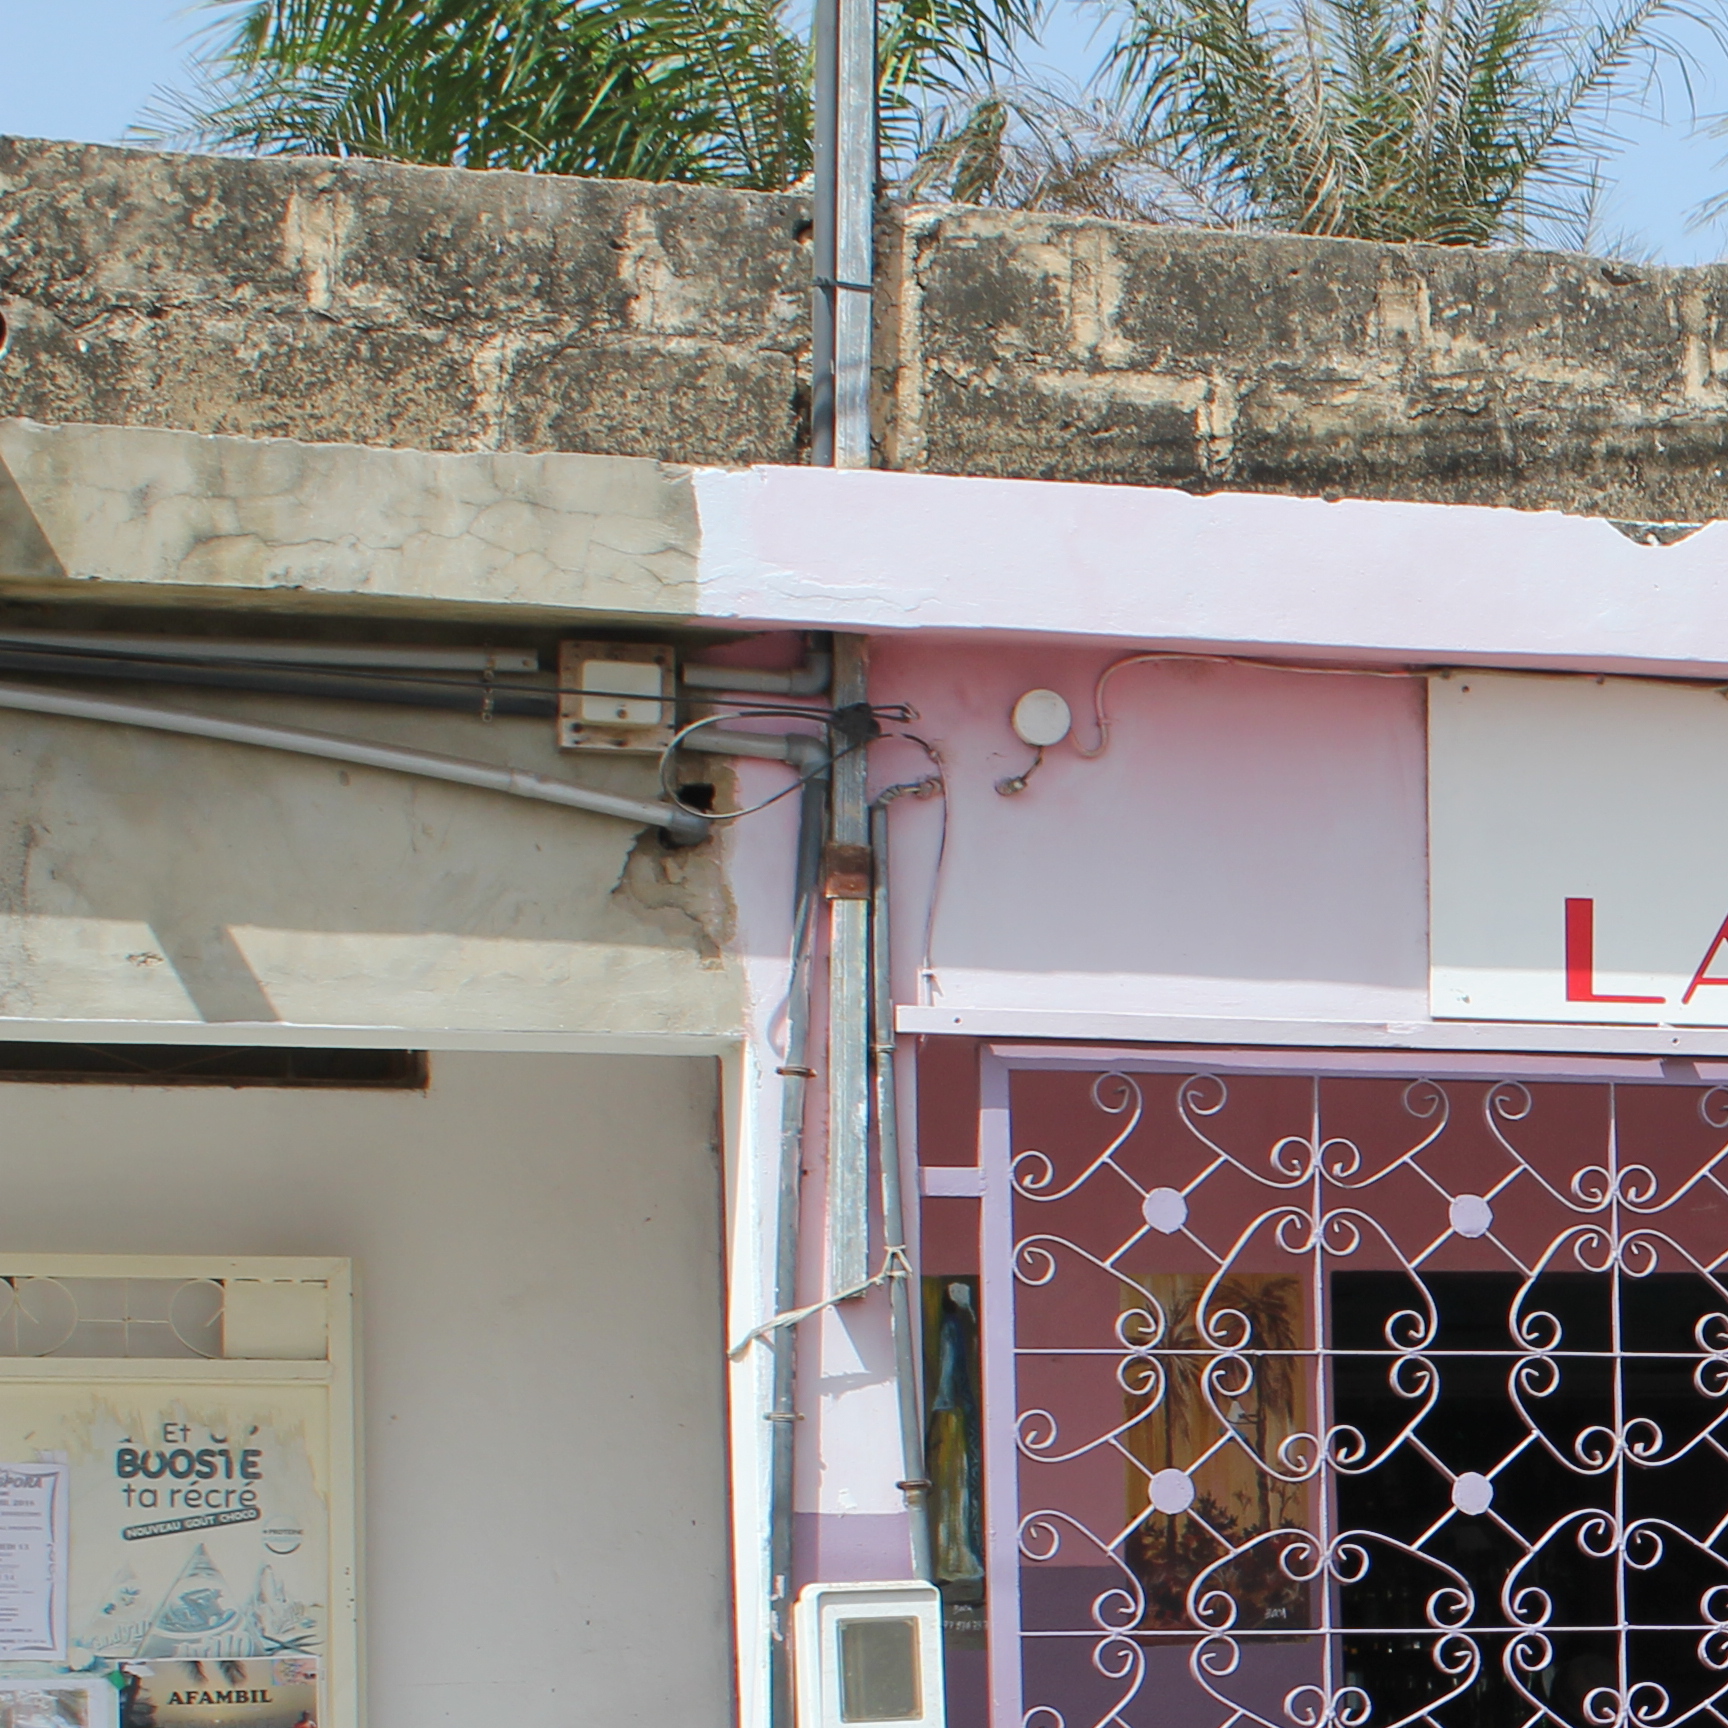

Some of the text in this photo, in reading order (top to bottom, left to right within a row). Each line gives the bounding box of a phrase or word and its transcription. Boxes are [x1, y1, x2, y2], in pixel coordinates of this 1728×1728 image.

[163, 1422, 192, 1443] Et
[122, 1481, 258, 1509] ta récré
[125, 1520, 182, 1539] NOUVEAU
[219, 1509, 257, 1523] CHOCO
[168, 1690, 274, 1705] AFAMBIL
